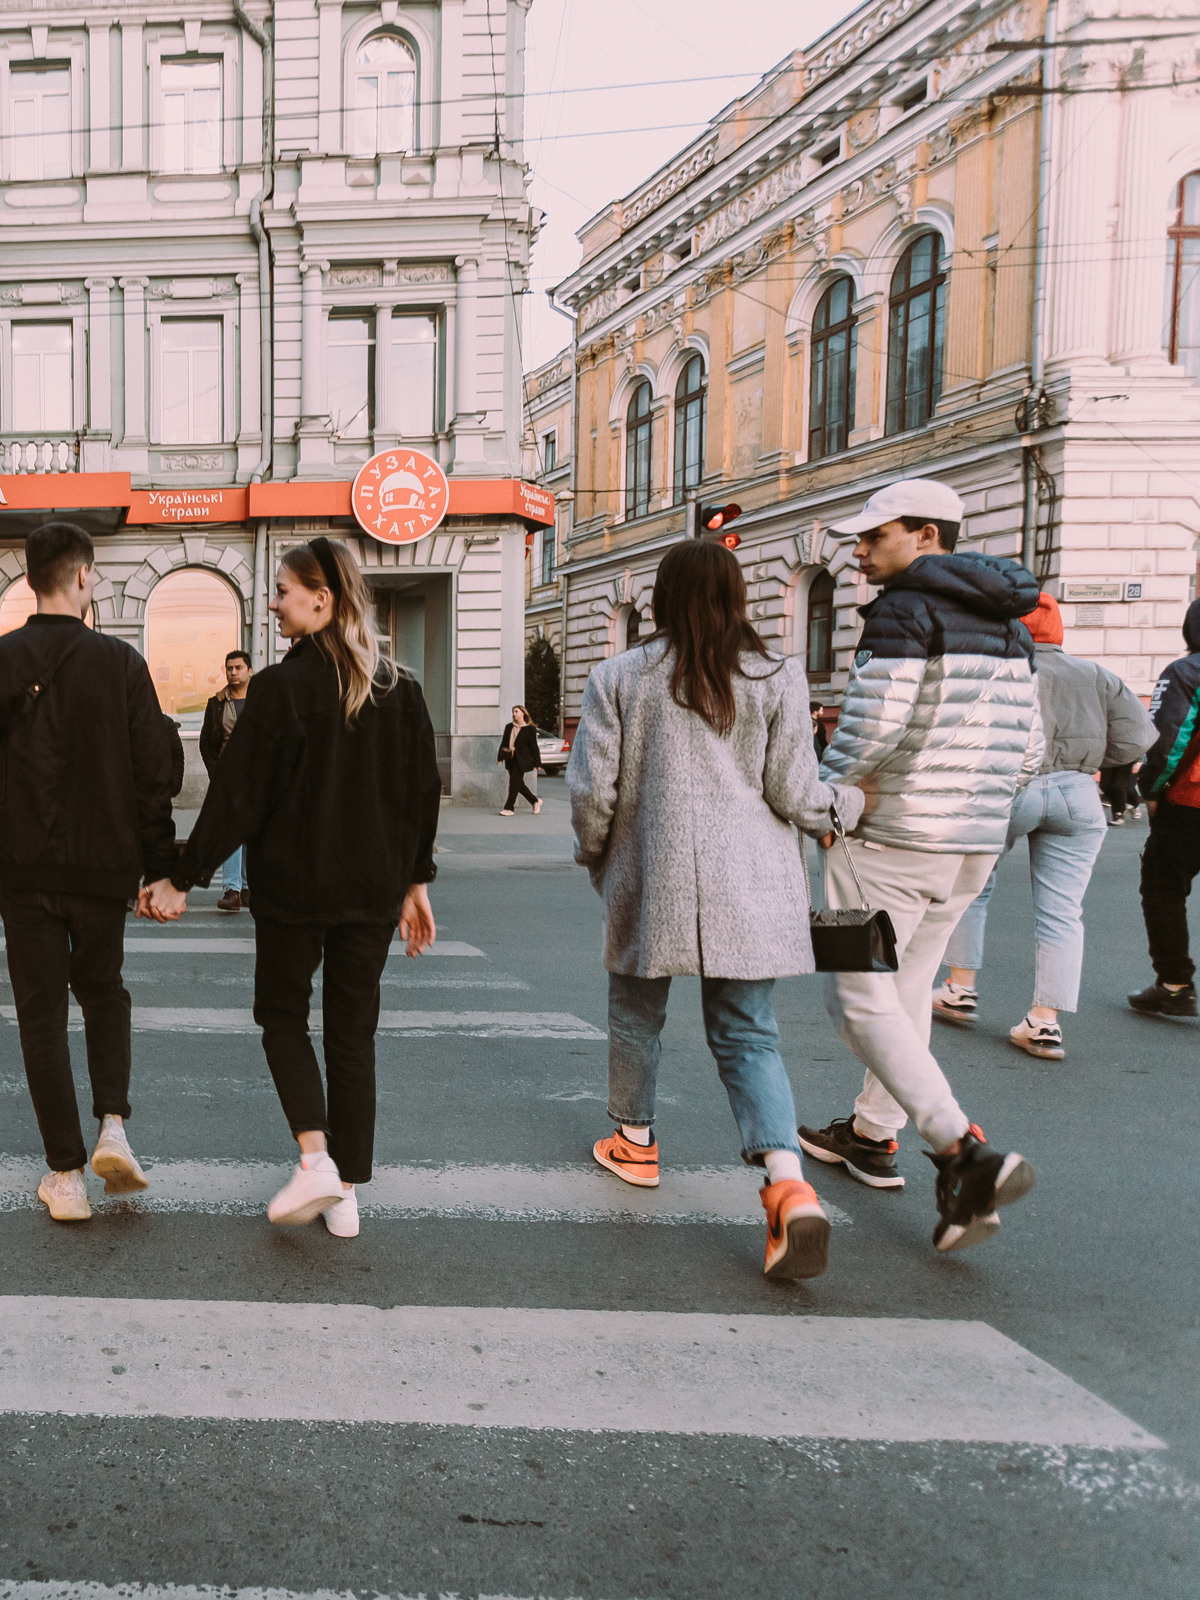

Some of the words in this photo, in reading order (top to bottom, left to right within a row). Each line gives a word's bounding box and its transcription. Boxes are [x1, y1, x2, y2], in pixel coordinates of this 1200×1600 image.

[360, 455, 441, 498] ПУЗАТА
[148, 491, 223, 508] Українські
[161, 507, 210, 521] страви
[371, 513, 433, 535] ХАТА
[1128, 586, 1141, 597] 28
